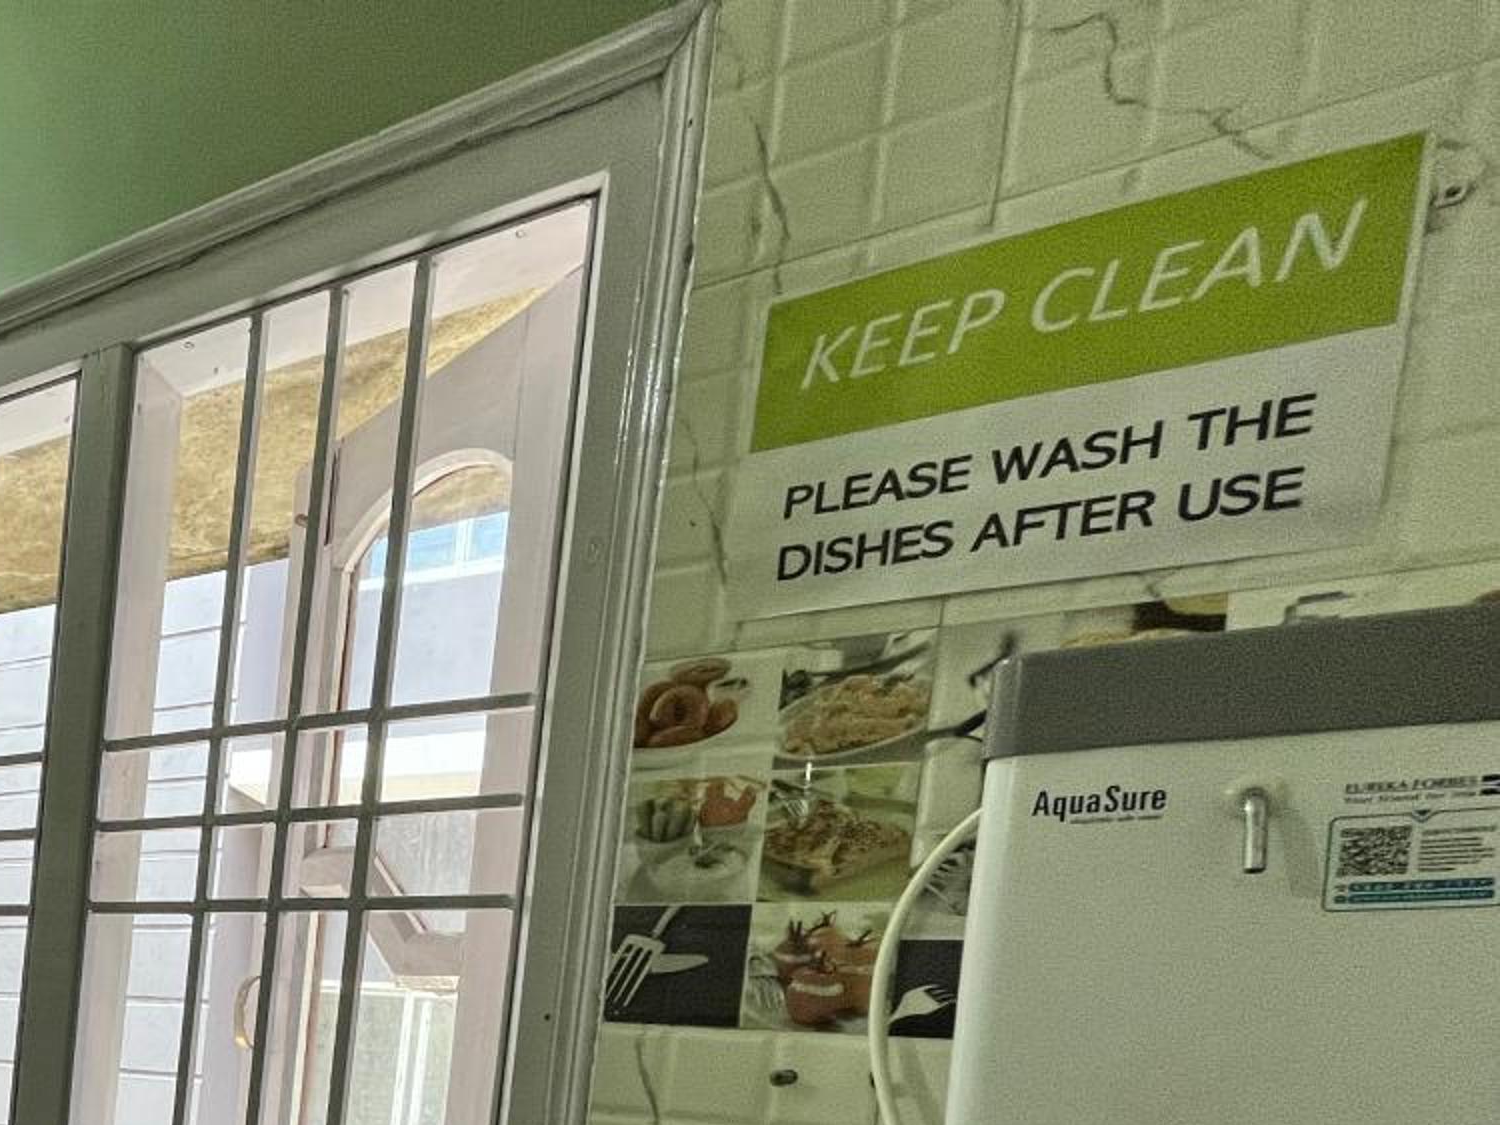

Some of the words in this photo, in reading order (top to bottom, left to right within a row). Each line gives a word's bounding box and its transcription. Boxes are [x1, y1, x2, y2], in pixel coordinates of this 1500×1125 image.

[801, 289, 1005, 391] KEEP
[1031, 199, 1368, 333] CLEAN
[782, 455, 974, 519] PLEASE
[991, 420, 1164, 485] WASH
[1187, 393, 1317, 451] THE
[776, 520, 954, 582] DISHES
[970, 490, 1155, 552] AFTER
[1177, 467, 1306, 521] USE
[1031, 785, 1168, 823] AquaSure
